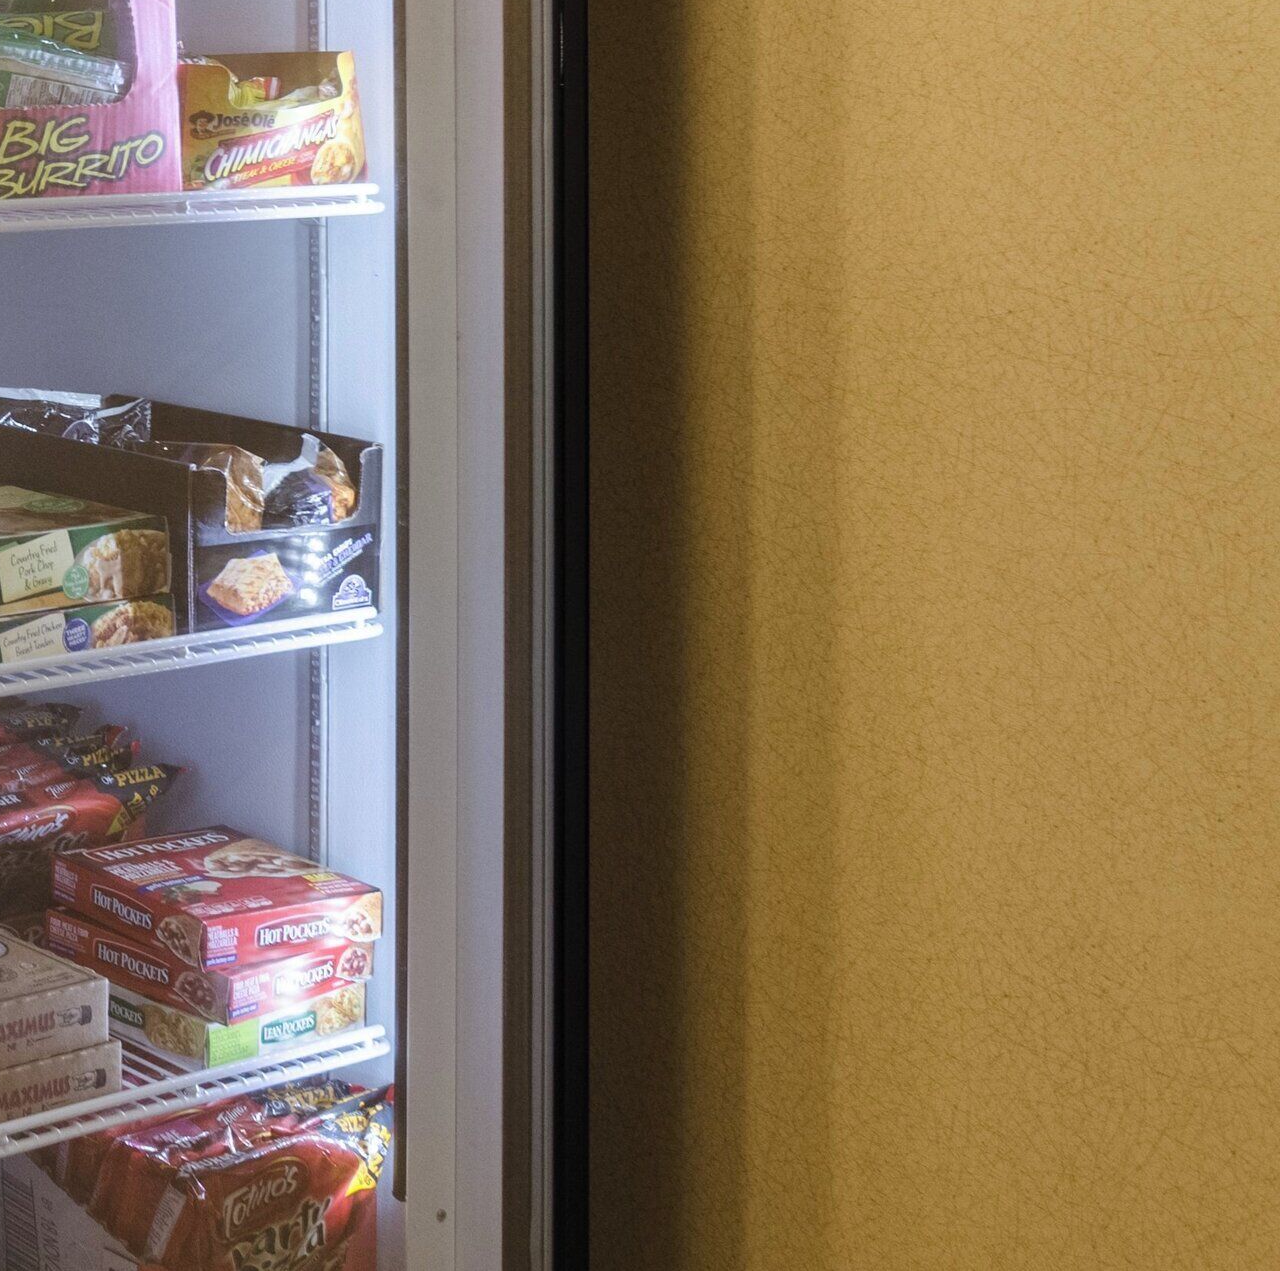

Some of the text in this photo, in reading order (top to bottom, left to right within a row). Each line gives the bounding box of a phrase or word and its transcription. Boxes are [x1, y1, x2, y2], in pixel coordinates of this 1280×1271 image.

[203, 113, 340, 182] CHIMICHANGAS
[10, 541, 58, 568] Country Fried
[18, 563, 38, 578] Pork
[114, 764, 167, 787] PIZZA
[95, 832, 230, 863] HOT POCKETS
[92, 888, 111, 908] HOT
[112, 895, 153, 930] POCKETS
[259, 915, 332, 947] HOT POCKETS
[97, 943, 170, 984] HOT POCKETS
[109, 1001, 144, 1027] POCKETS
[263, 1014, 316, 1043] LEAN POCKETS
[223, 1164, 299, 1242] Totino's
